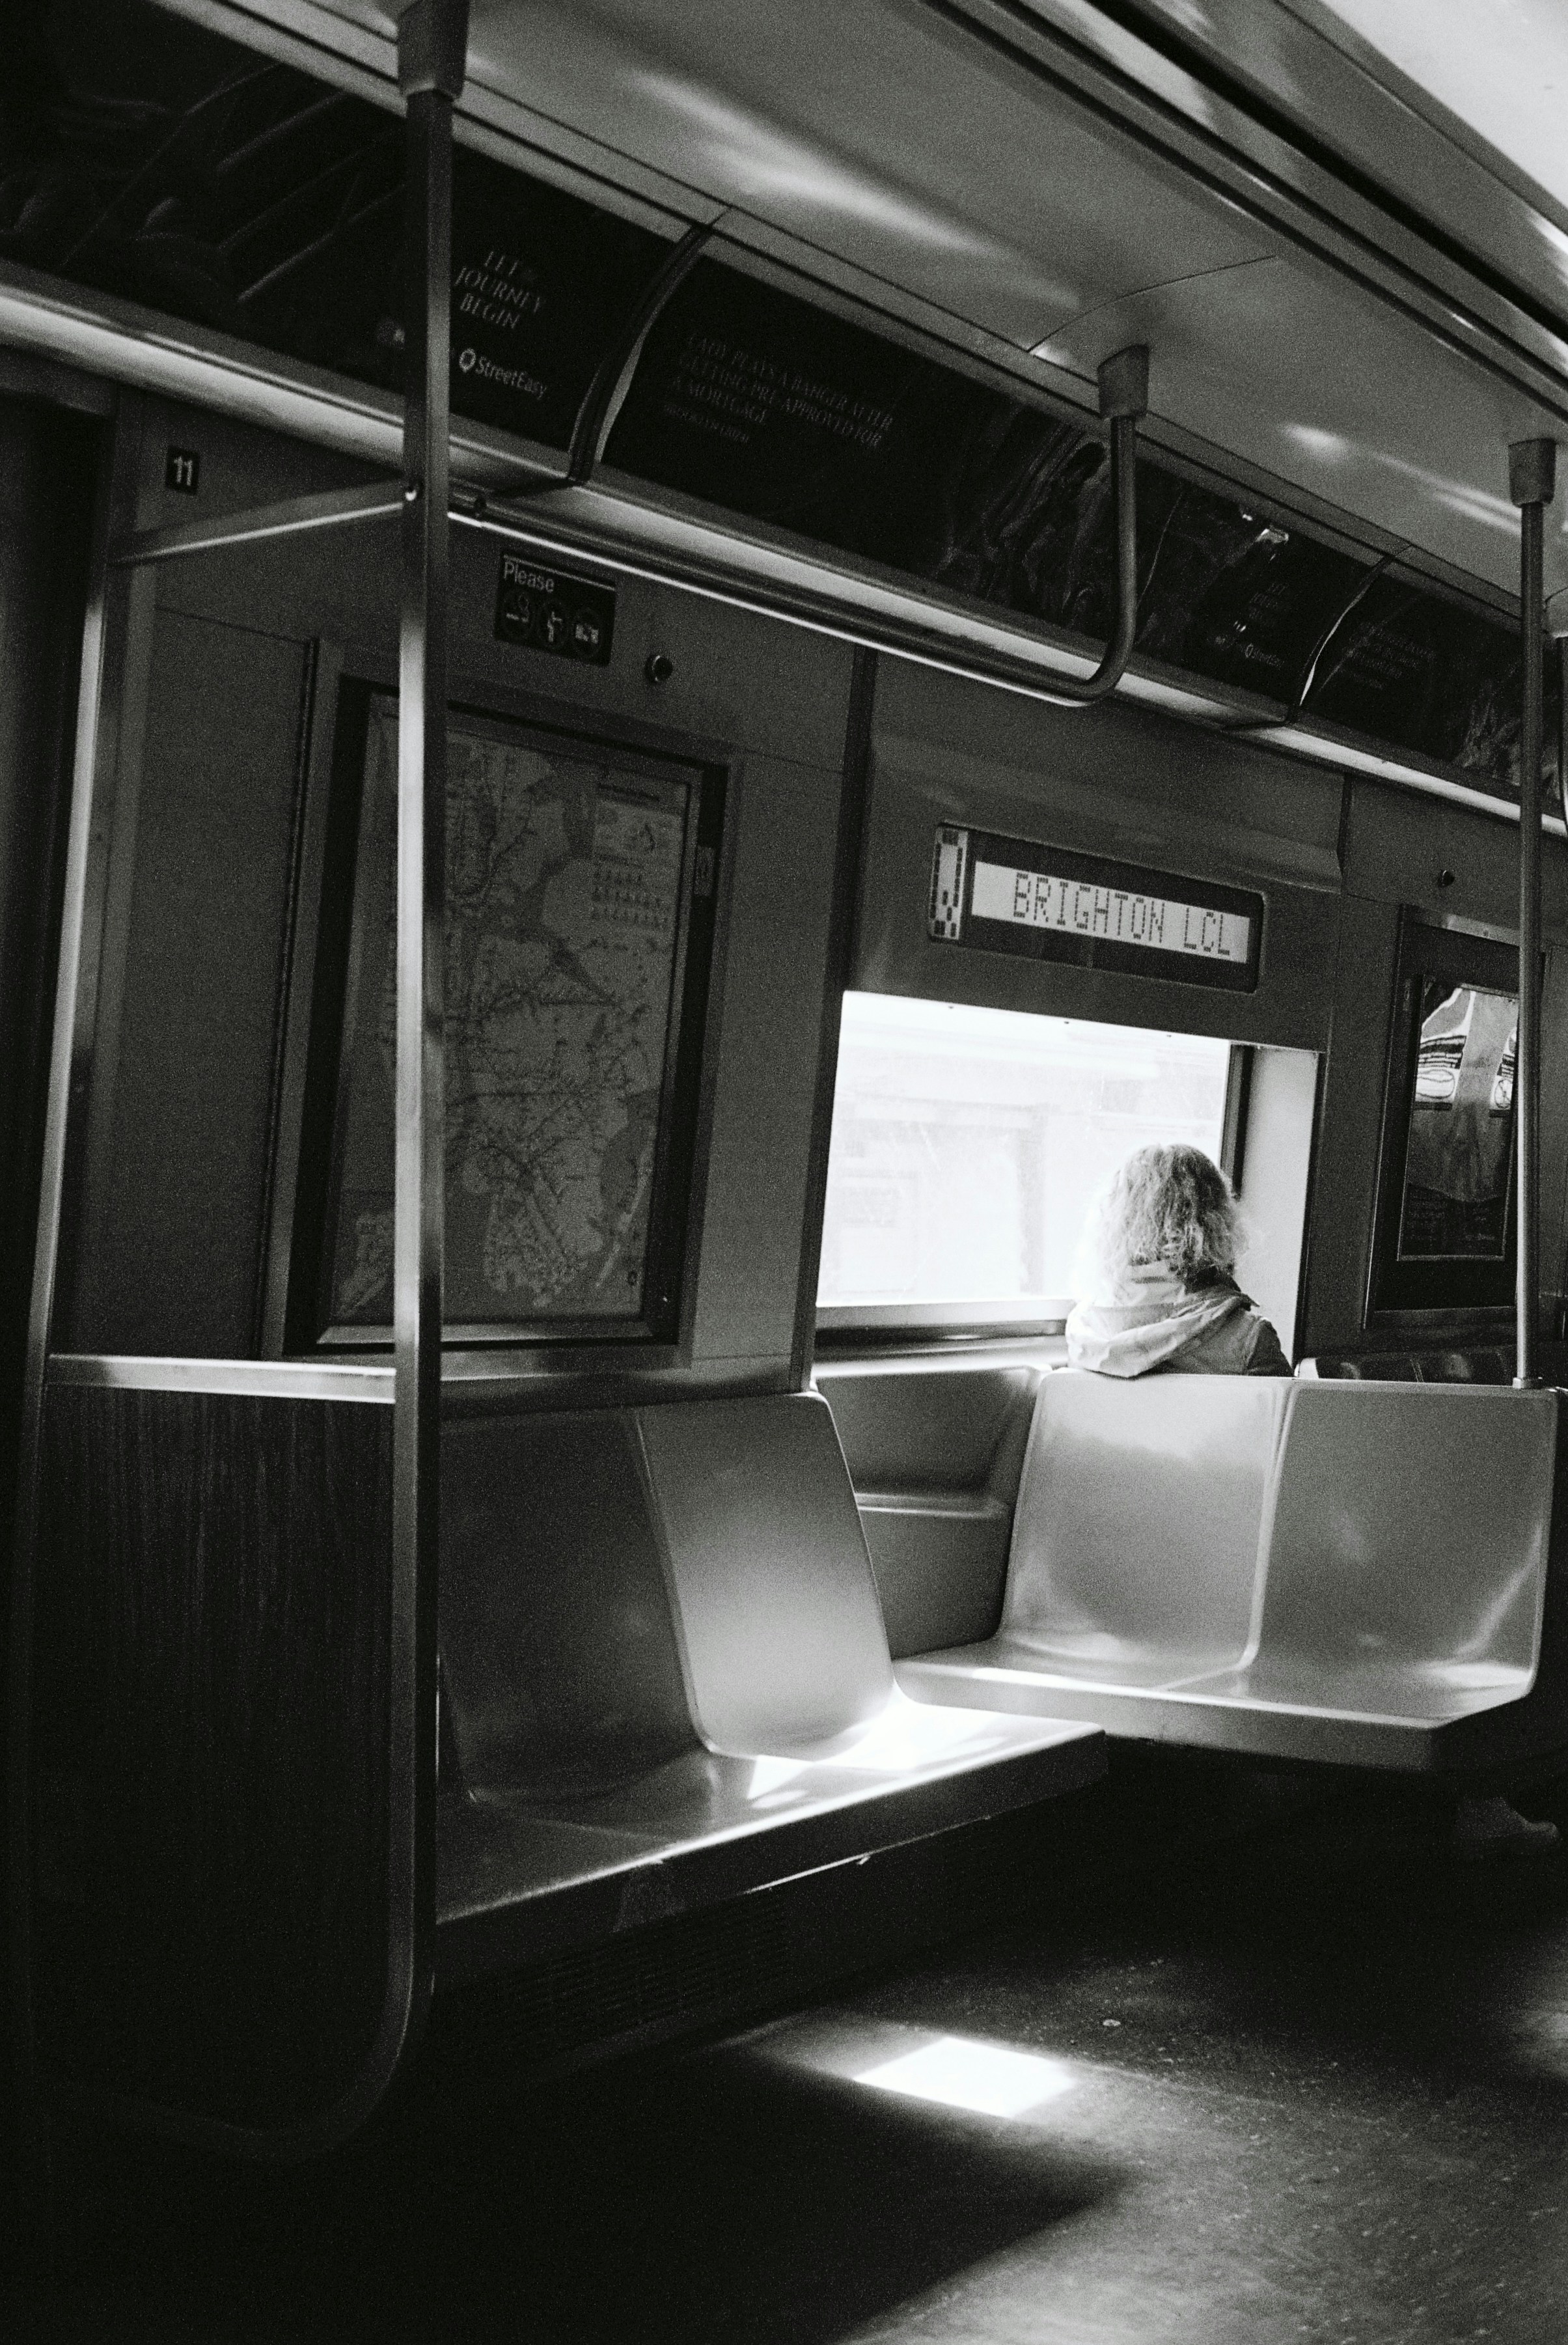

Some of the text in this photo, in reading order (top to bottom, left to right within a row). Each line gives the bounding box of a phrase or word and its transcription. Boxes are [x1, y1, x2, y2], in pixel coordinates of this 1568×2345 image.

[454, 266, 544, 314] JOURNEY
[460, 292, 521, 329] BEGIN
[475, 355, 547, 400] StreetEasy
[854, 424, 883, 449] FOR
[173, 454, 193, 487] 11
[502, 561, 555, 593] Please
[1012, 872, 1231, 956] BRIGHTON LCL
